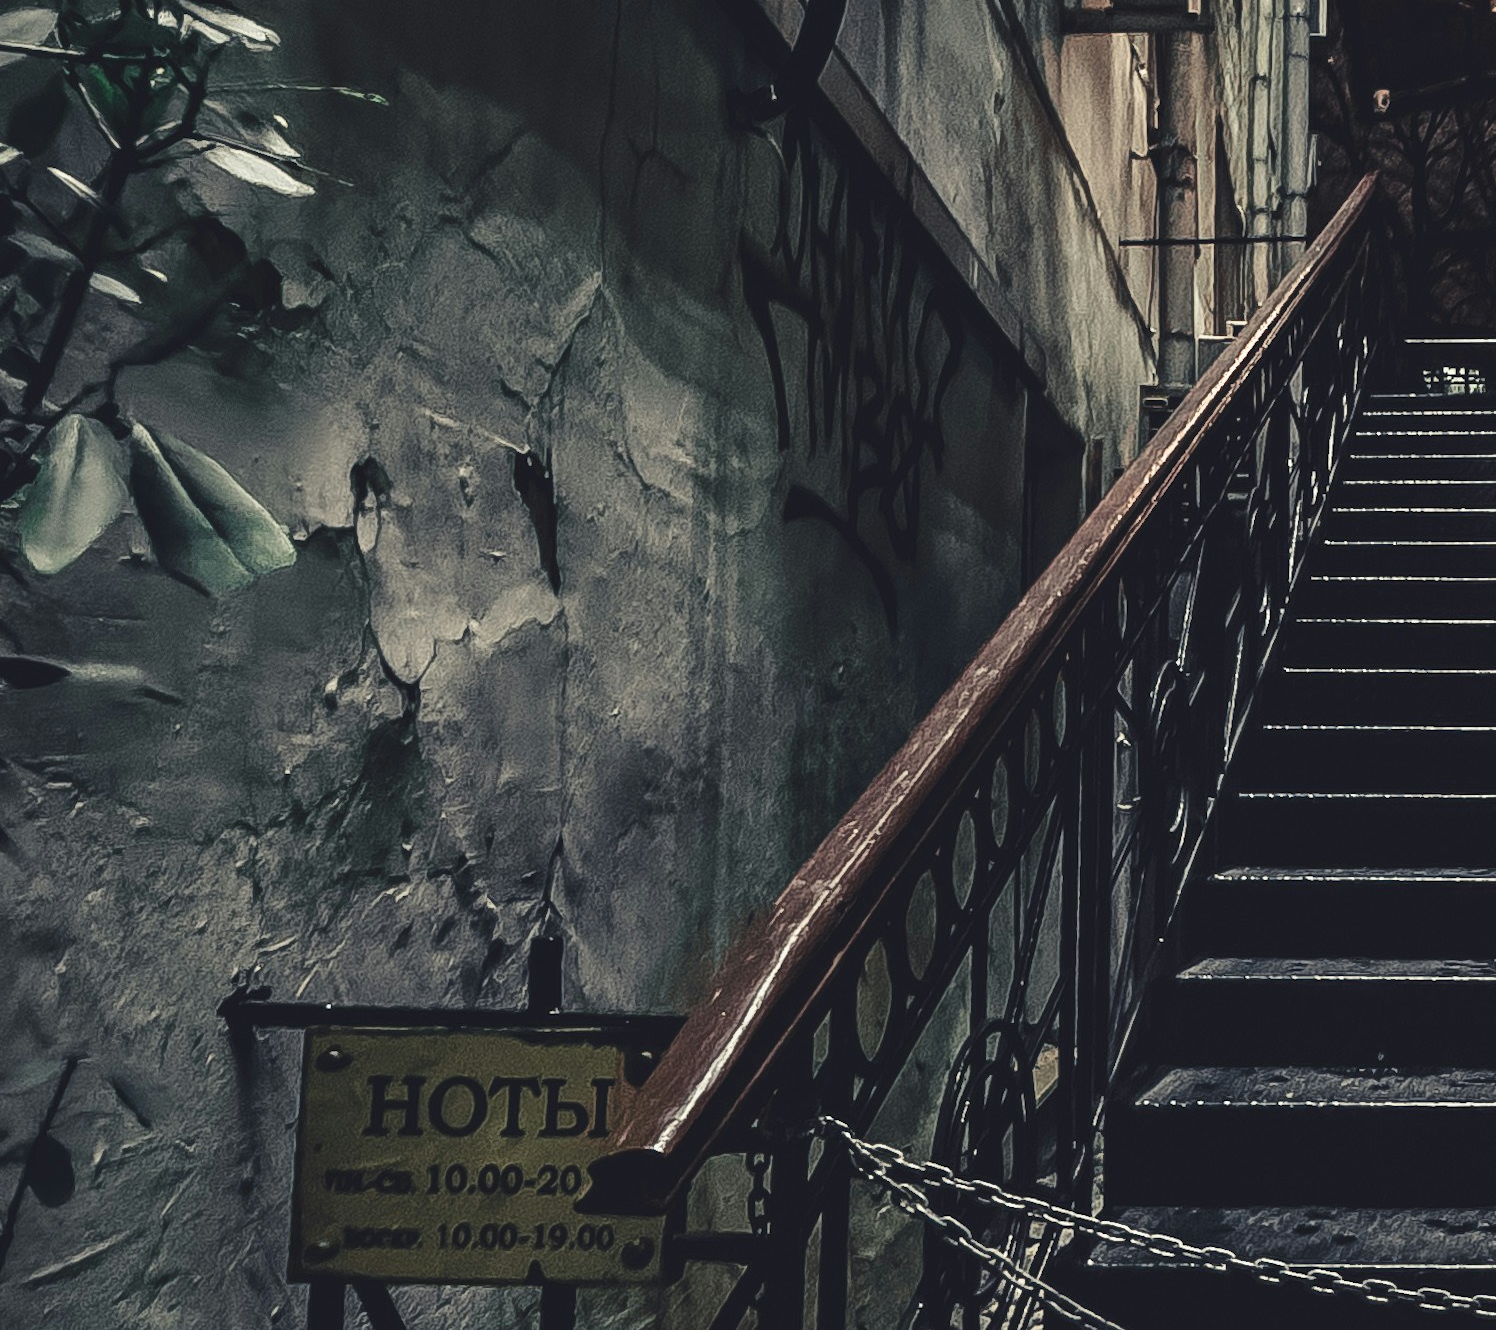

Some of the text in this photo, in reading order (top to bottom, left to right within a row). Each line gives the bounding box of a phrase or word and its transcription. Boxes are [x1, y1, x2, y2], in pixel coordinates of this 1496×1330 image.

[362, 1074, 615, 1138] НОТЫ
[425, 1162, 583, 1194] 10.00-20
[437, 1221, 615, 1252] 10.00-19.00
